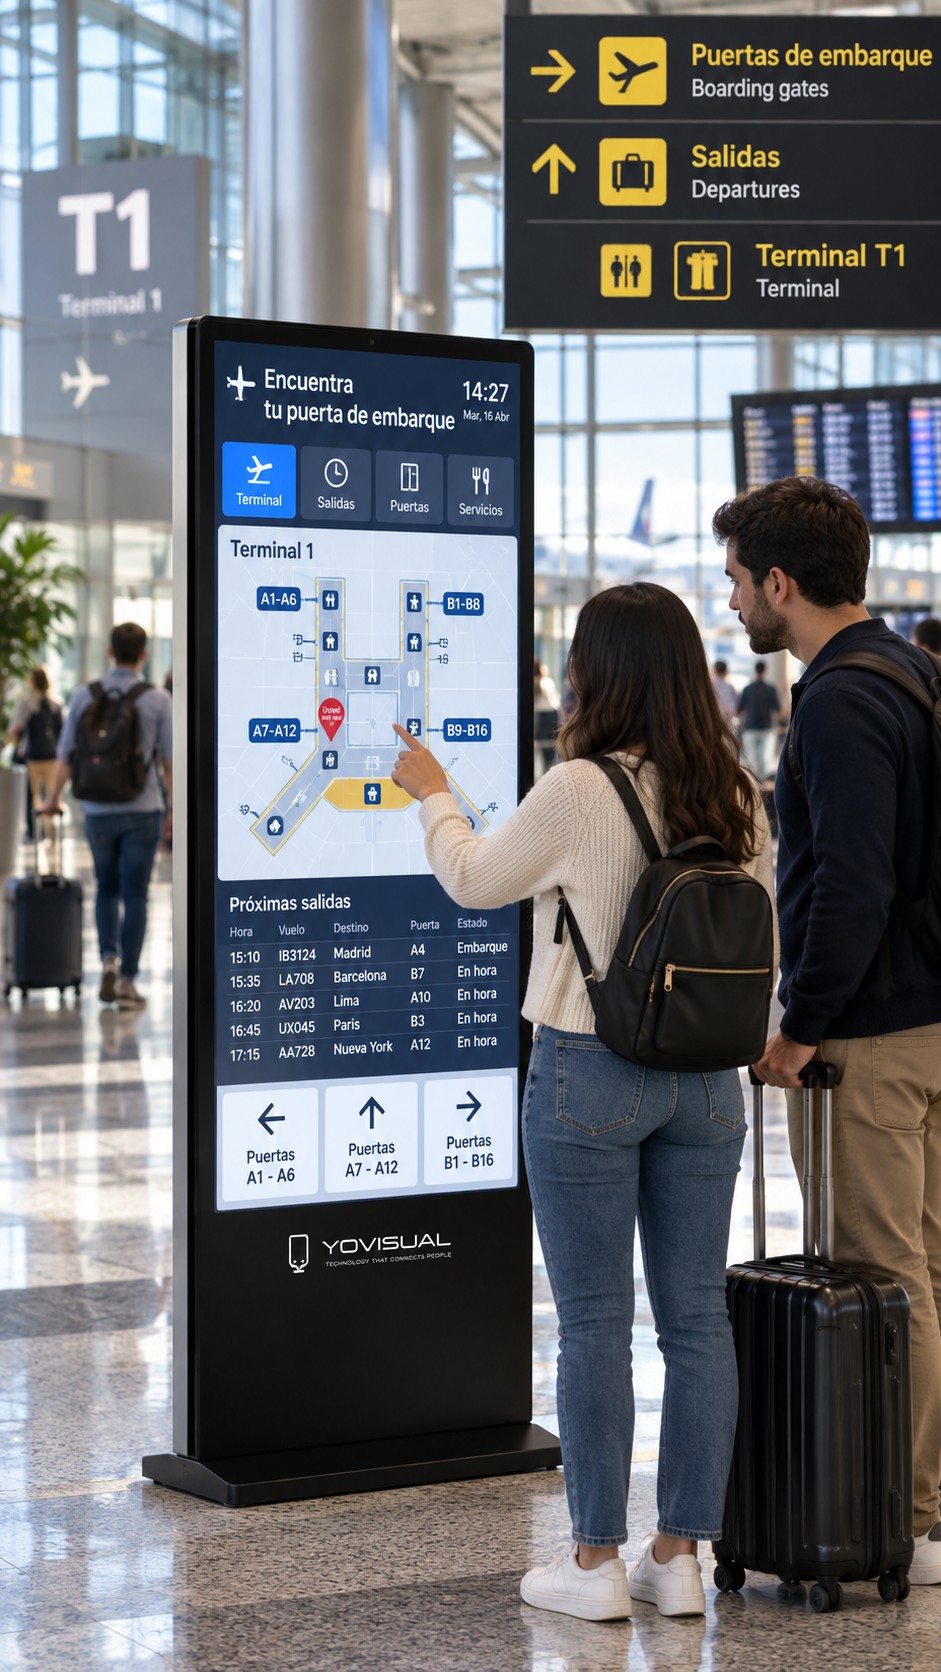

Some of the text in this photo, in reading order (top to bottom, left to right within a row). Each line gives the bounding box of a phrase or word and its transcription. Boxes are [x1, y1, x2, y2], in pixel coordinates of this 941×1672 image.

[691, 42, 933, 71] Puertas de embarque
[691, 78, 829, 102] Boarding gates
[691, 145, 781, 168] Salidas
[691, 179, 801, 202] Departures
[58, 188, 150, 275] T1
[755, 243, 906, 267] Terminal T1
[756, 279, 840, 298] Terminal
[58, 288, 162, 319] Terminal 1
[264, 368, 354, 393] Encuentra
[463, 381, 509, 402] 14:27
[264, 401, 455, 433] tu puerta de embarque
[463, 410, 510, 423] Mar, 16 Abr
[236, 493, 282, 507] Terminal
[317, 496, 355, 510] Salidas
[390, 500, 429, 513] Puertas
[459, 503, 503, 516] Servicios
[230, 539, 314, 560] Terminal 1
[261, 592, 297, 606] A1-A6
[447, 597, 480, 610] B1-B8
[253, 724, 296, 737] A7-A12
[447, 724, 488, 736] B9-B16
[230, 894, 351, 913] Próximas salidas
[230, 918, 488, 938] Hora Vuelo Destino Puerta Estado
[230, 941, 508, 964] 15:10 IB3124 Madrid A4 Embarque
[230, 965, 497, 989] 15:35 LA708 Barcelona B7 En hora
[230, 988, 497, 1013] 16:20 AV203 Lima A10 En hora
[230, 1012, 497, 1037] 16:45 UX045 Paris B3 En hora
[230, 1035, 497, 1062] 17:15 AA728 Nueva York A12 En hora
[348, 1142, 395, 1157] Puertas
[446, 1135, 492, 1150] Puertas
[246, 1149, 295, 1164] Puertas
[444, 1155, 458, 1170] B1
[472, 1153, 494, 1168] B16
[247, 1170, 264, 1185] A1
[277, 1167, 295, 1183] A6
[345, 1163, 362, 1178] A7
[375, 1160, 398, 1175] A12
[322, 1233, 451, 1255] YOVISUAL
